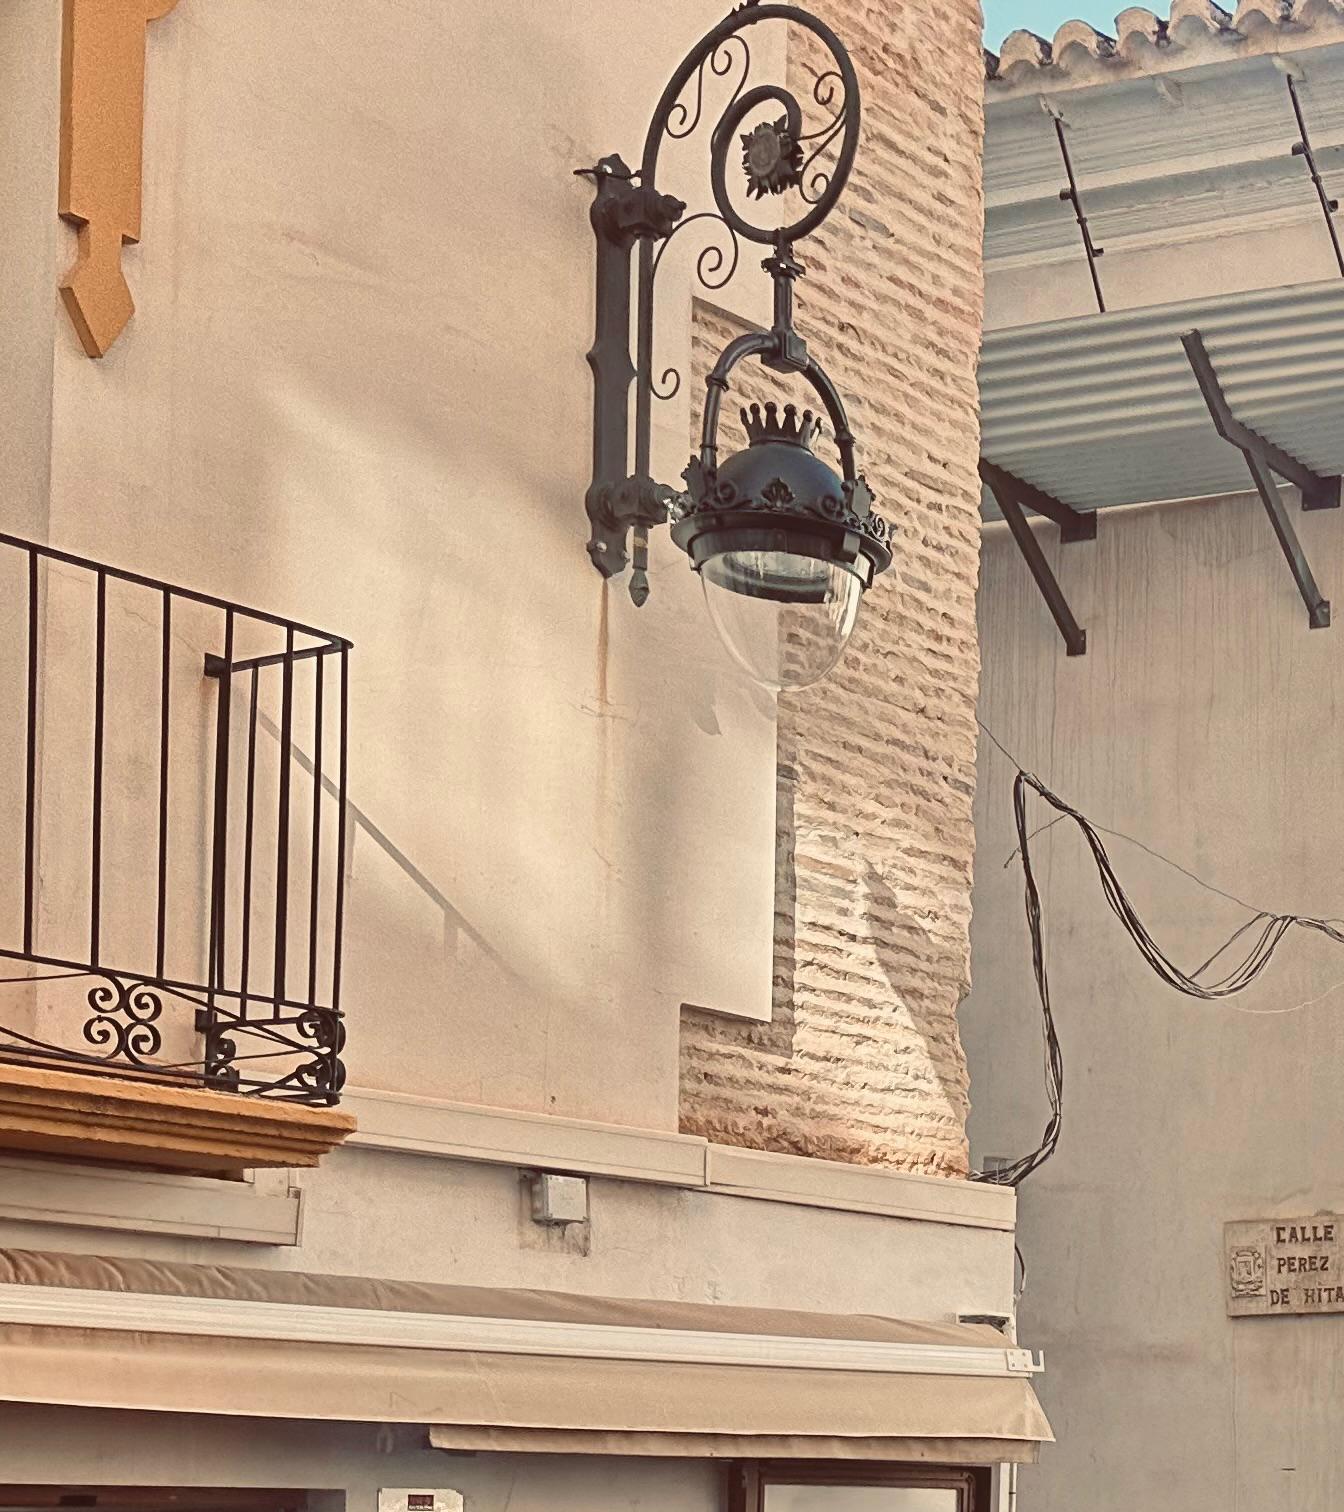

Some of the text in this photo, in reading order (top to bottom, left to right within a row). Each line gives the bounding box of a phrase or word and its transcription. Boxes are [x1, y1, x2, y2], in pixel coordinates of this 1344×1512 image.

[1275, 1224, 1334, 1244] CALLE
[1277, 1255, 1330, 1274] PEREZ
[1270, 1287, 1290, 1307] DE
